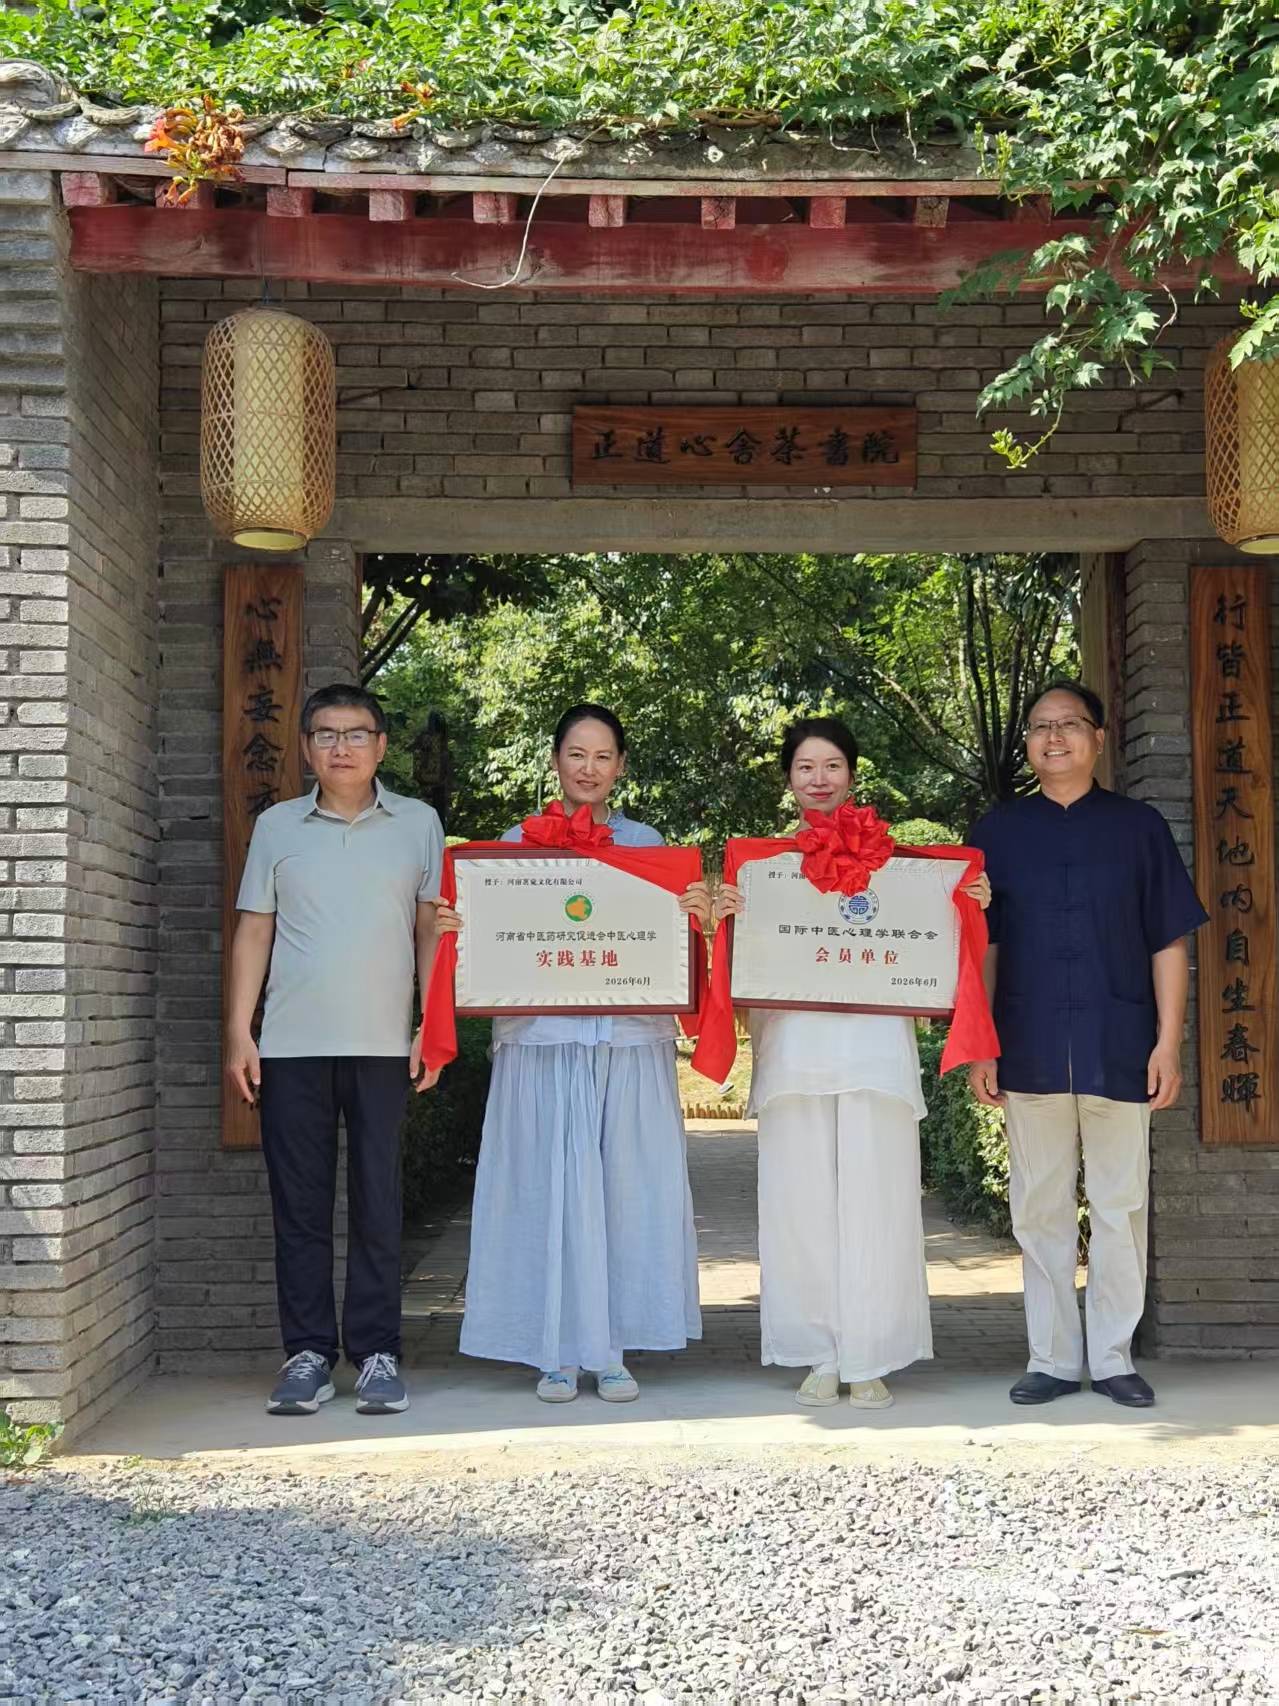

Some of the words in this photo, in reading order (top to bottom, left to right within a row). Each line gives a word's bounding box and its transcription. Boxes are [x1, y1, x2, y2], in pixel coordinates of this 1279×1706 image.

[495, 931, 657, 942] 河南省中医药研究促进会中医心理学
[778, 924, 939, 940] 国际中医心理学联合会
[536, 950, 619, 967] 实践基地
[815, 946, 899, 965] 会员单位
[605, 976, 651, 986] 2026年6月
[890, 976, 938, 988] 2026年6月
